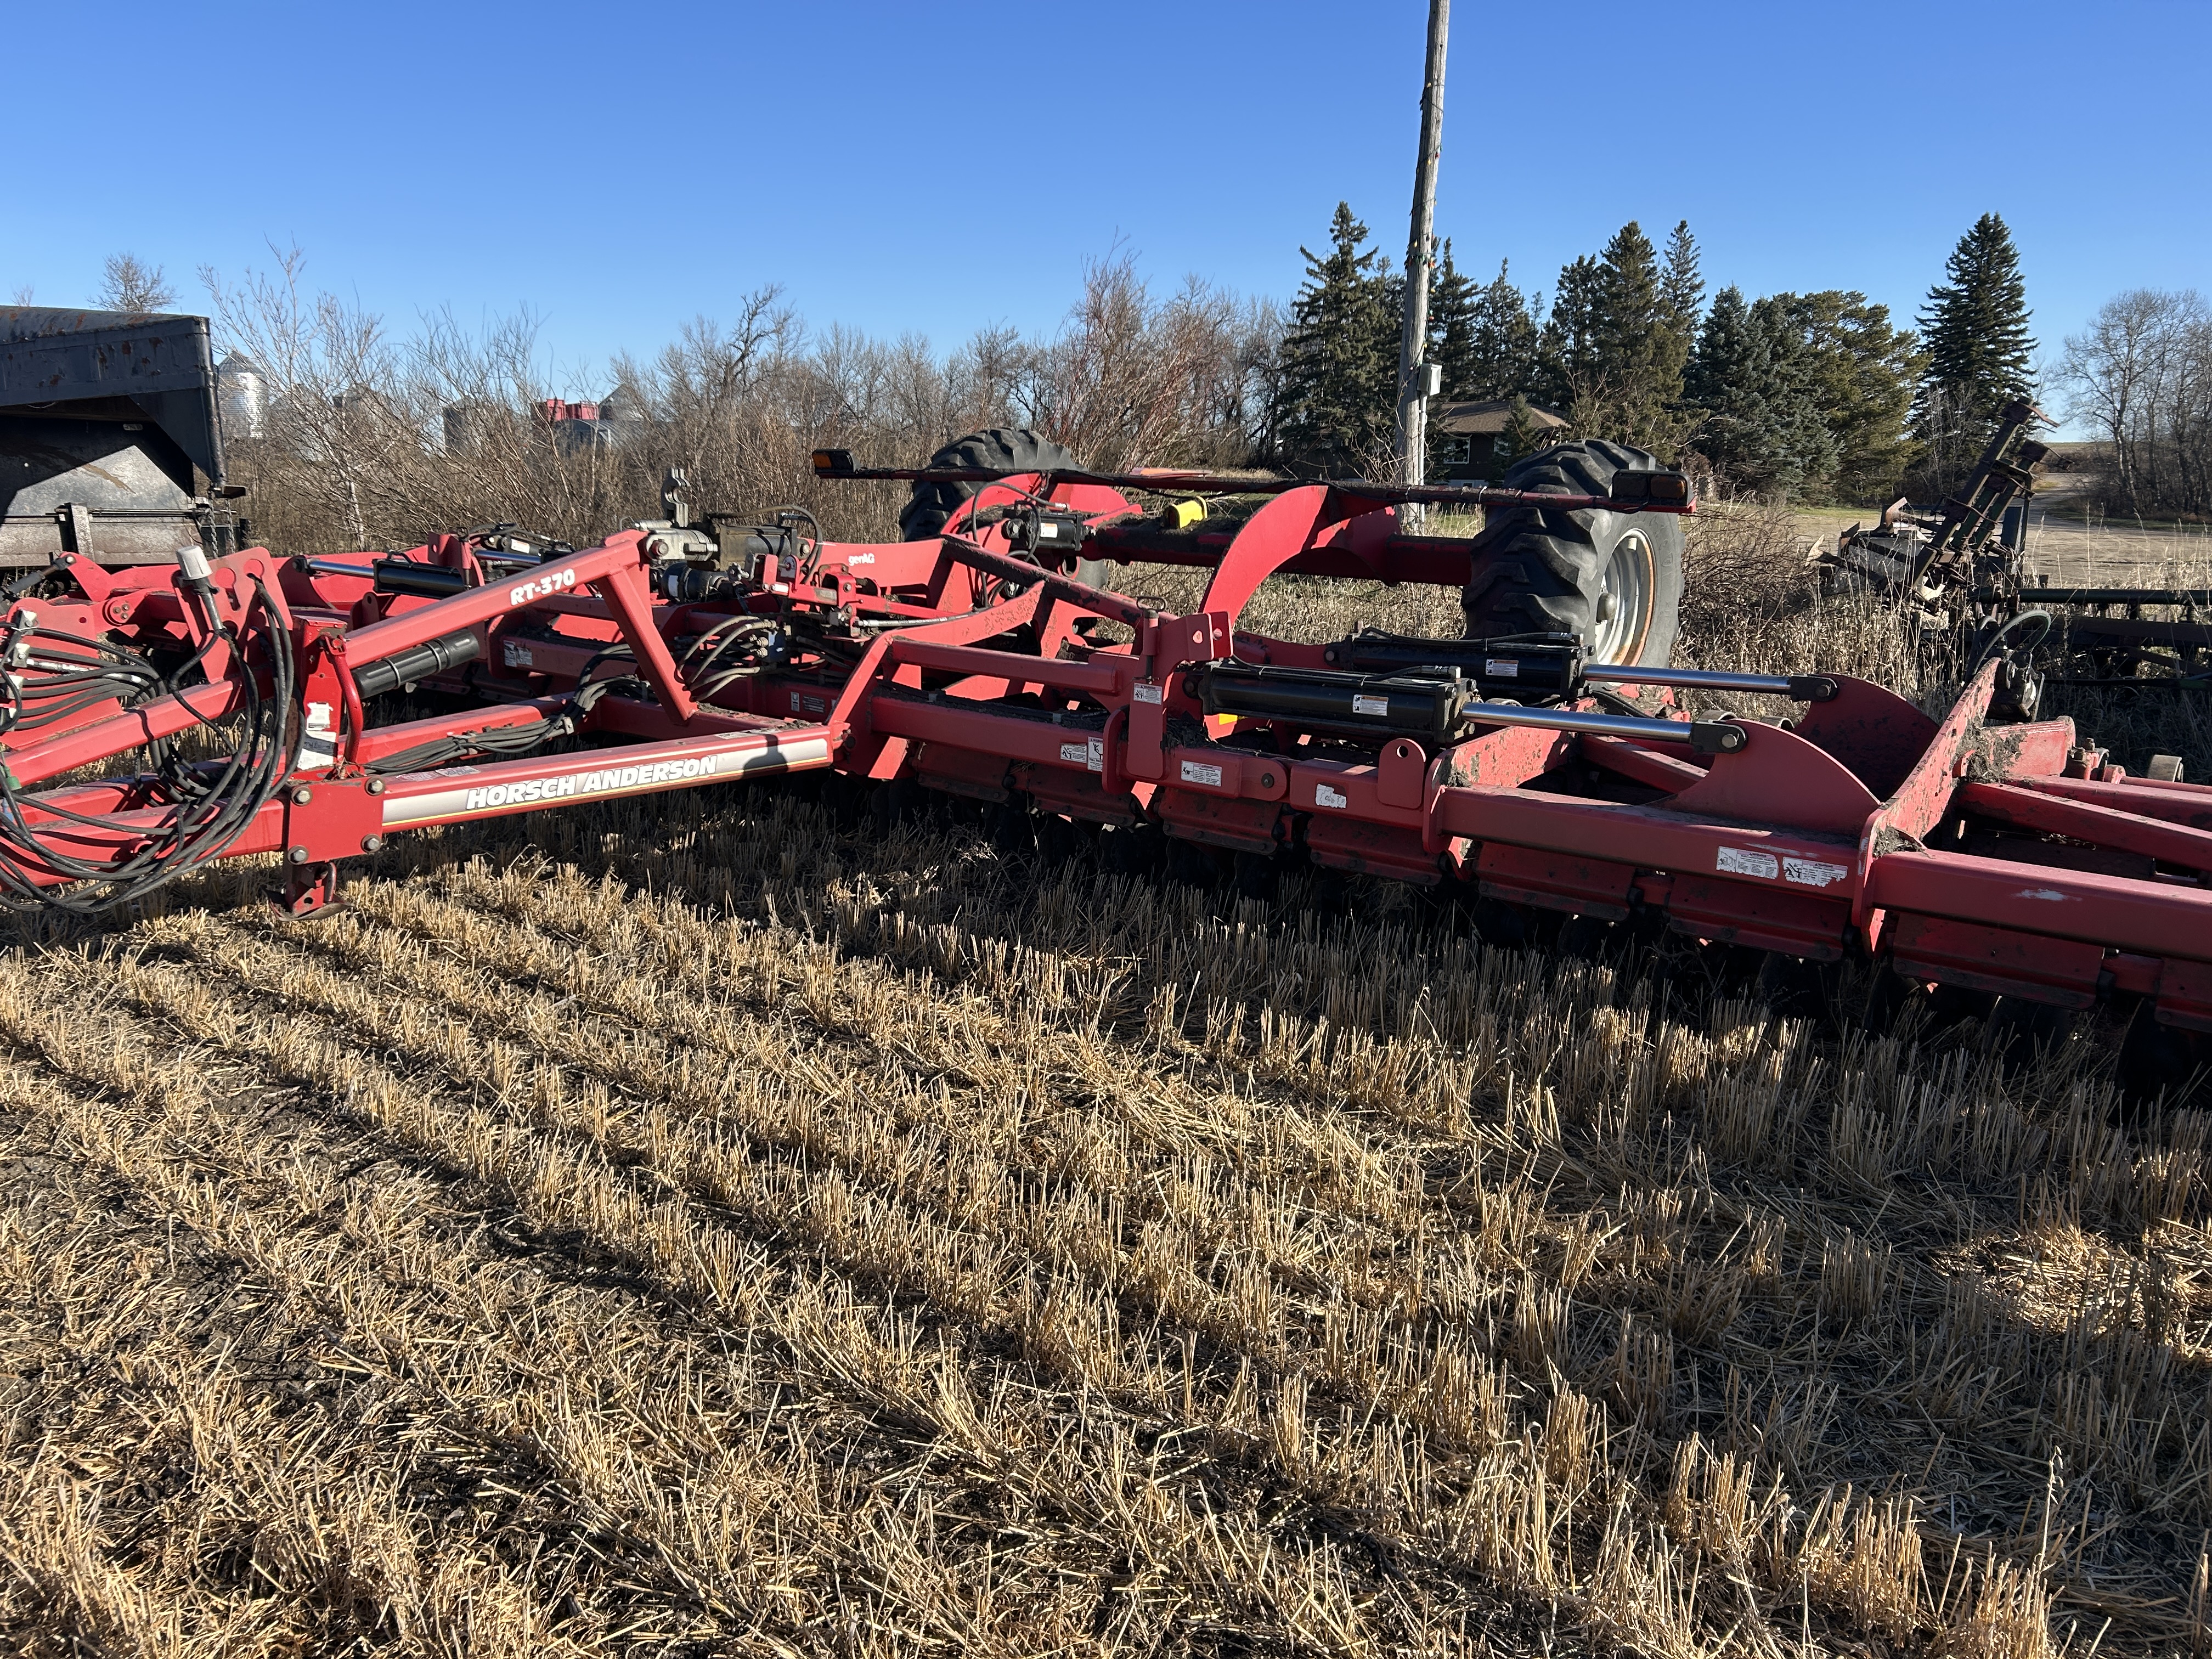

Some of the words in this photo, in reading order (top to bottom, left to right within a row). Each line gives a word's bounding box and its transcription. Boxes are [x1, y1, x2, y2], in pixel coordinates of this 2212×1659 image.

[510, 568, 575, 606] RT-370
[466, 775, 577, 809] HORSCH
[582, 755, 718, 793] ANDERSON
